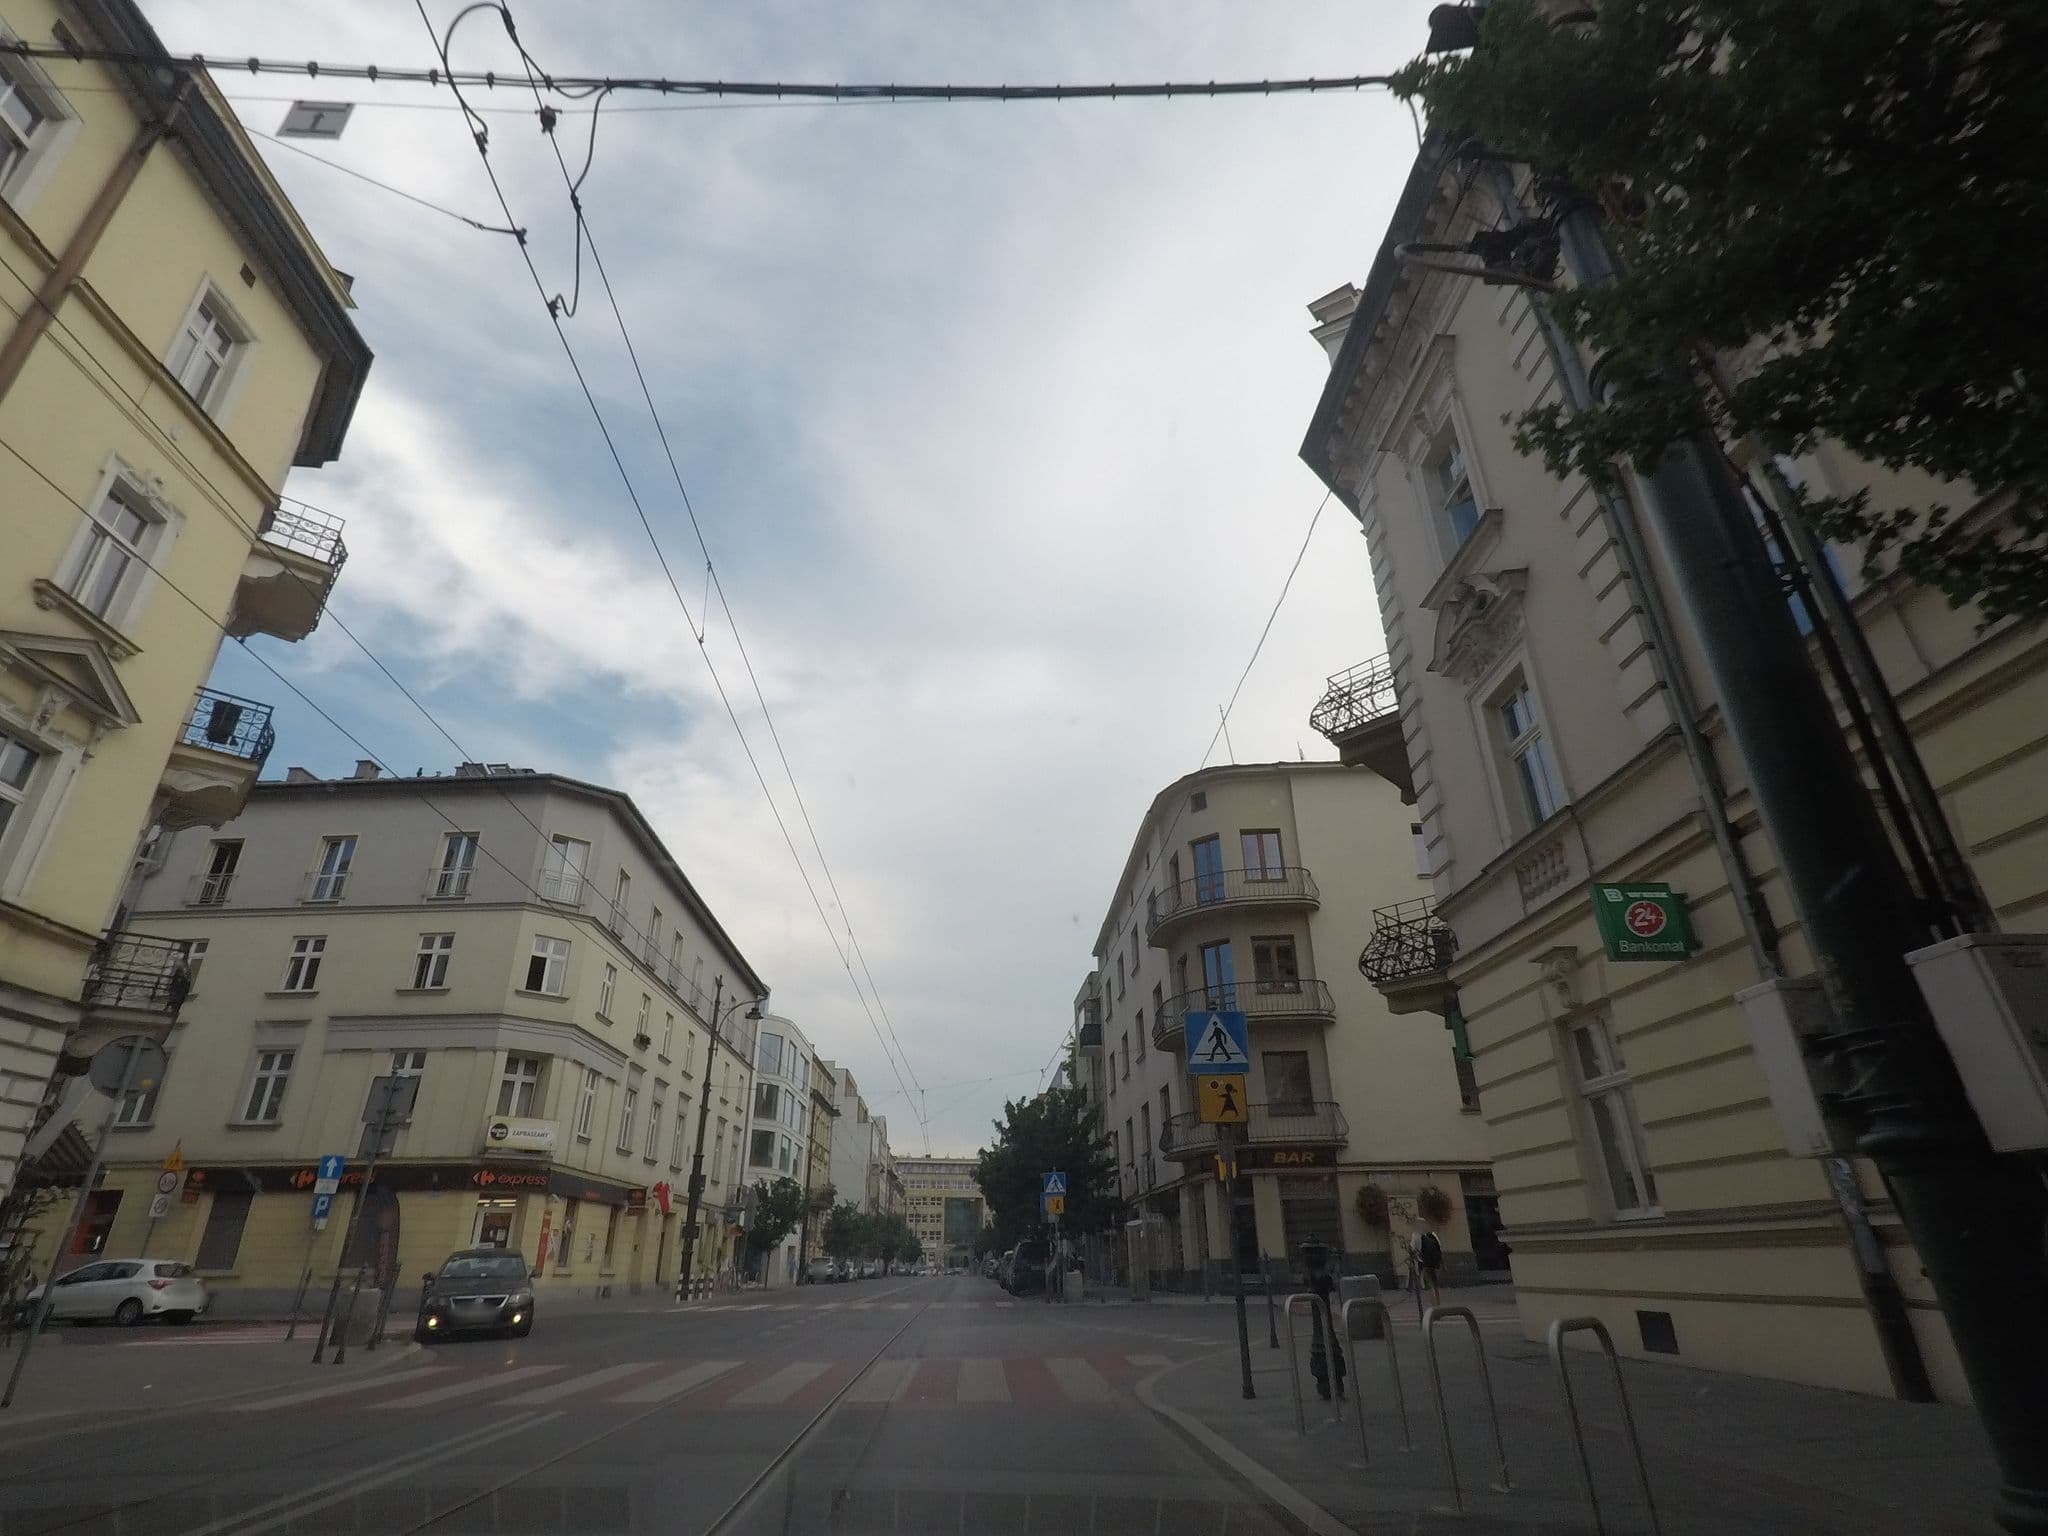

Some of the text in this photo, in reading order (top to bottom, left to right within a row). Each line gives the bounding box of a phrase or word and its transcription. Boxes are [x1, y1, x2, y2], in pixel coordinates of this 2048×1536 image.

[1633, 907, 1657, 927] 24
[1619, 939, 1686, 953] Bankomat
[1273, 1152, 1315, 1164] BAR
[498, 1173, 548, 1187] express
[315, 1197, 329, 1215] P
